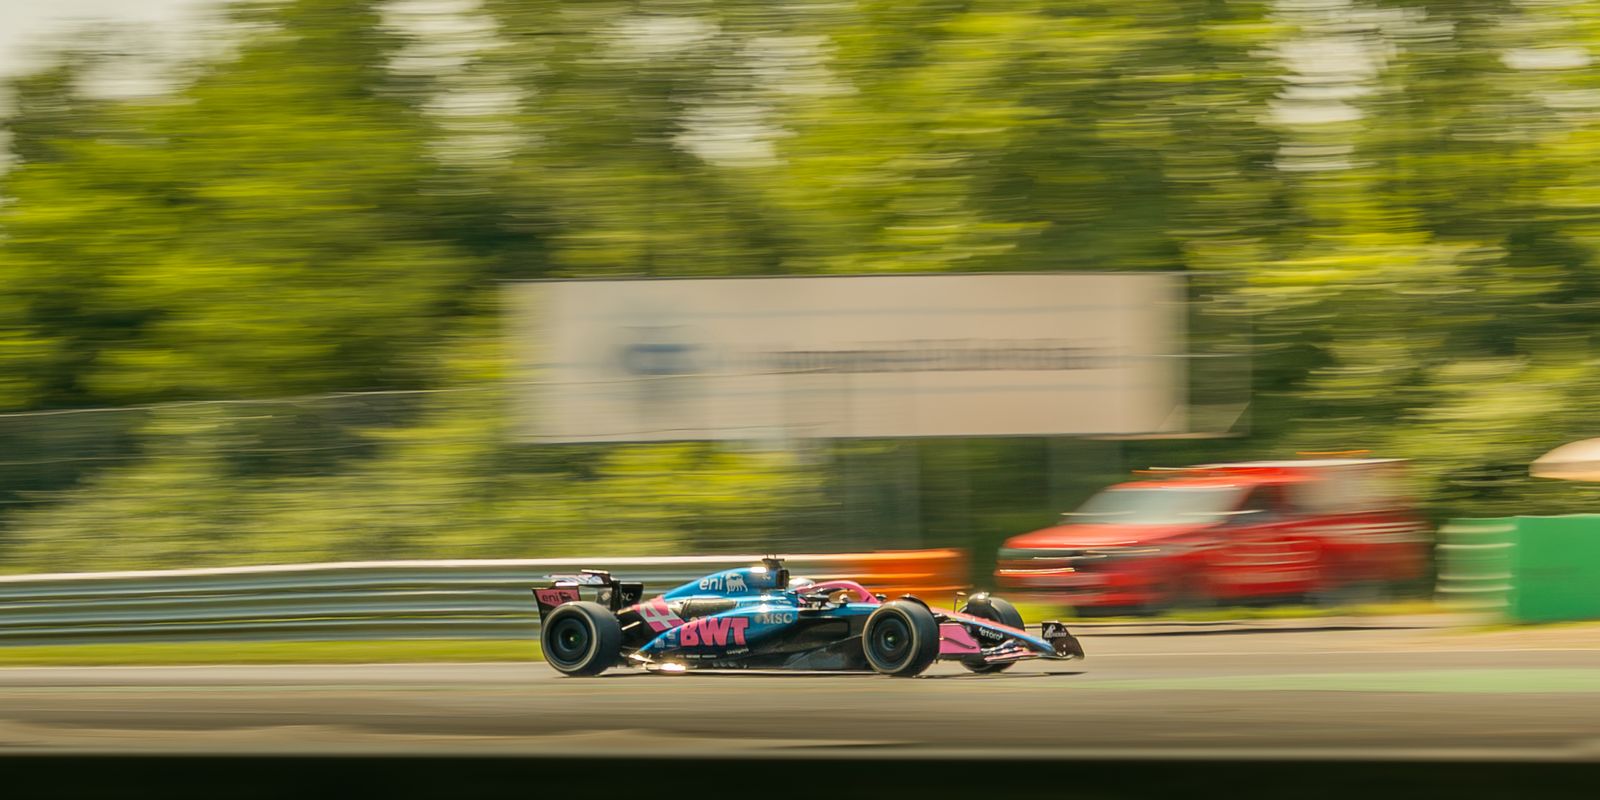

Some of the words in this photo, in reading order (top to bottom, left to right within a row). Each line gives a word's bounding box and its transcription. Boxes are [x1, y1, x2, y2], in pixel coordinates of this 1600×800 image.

[699, 575, 723, 590] eni
[542, 592, 559, 602] eni
[763, 614, 792, 624] MSC
[680, 617, 748, 646] BWT
